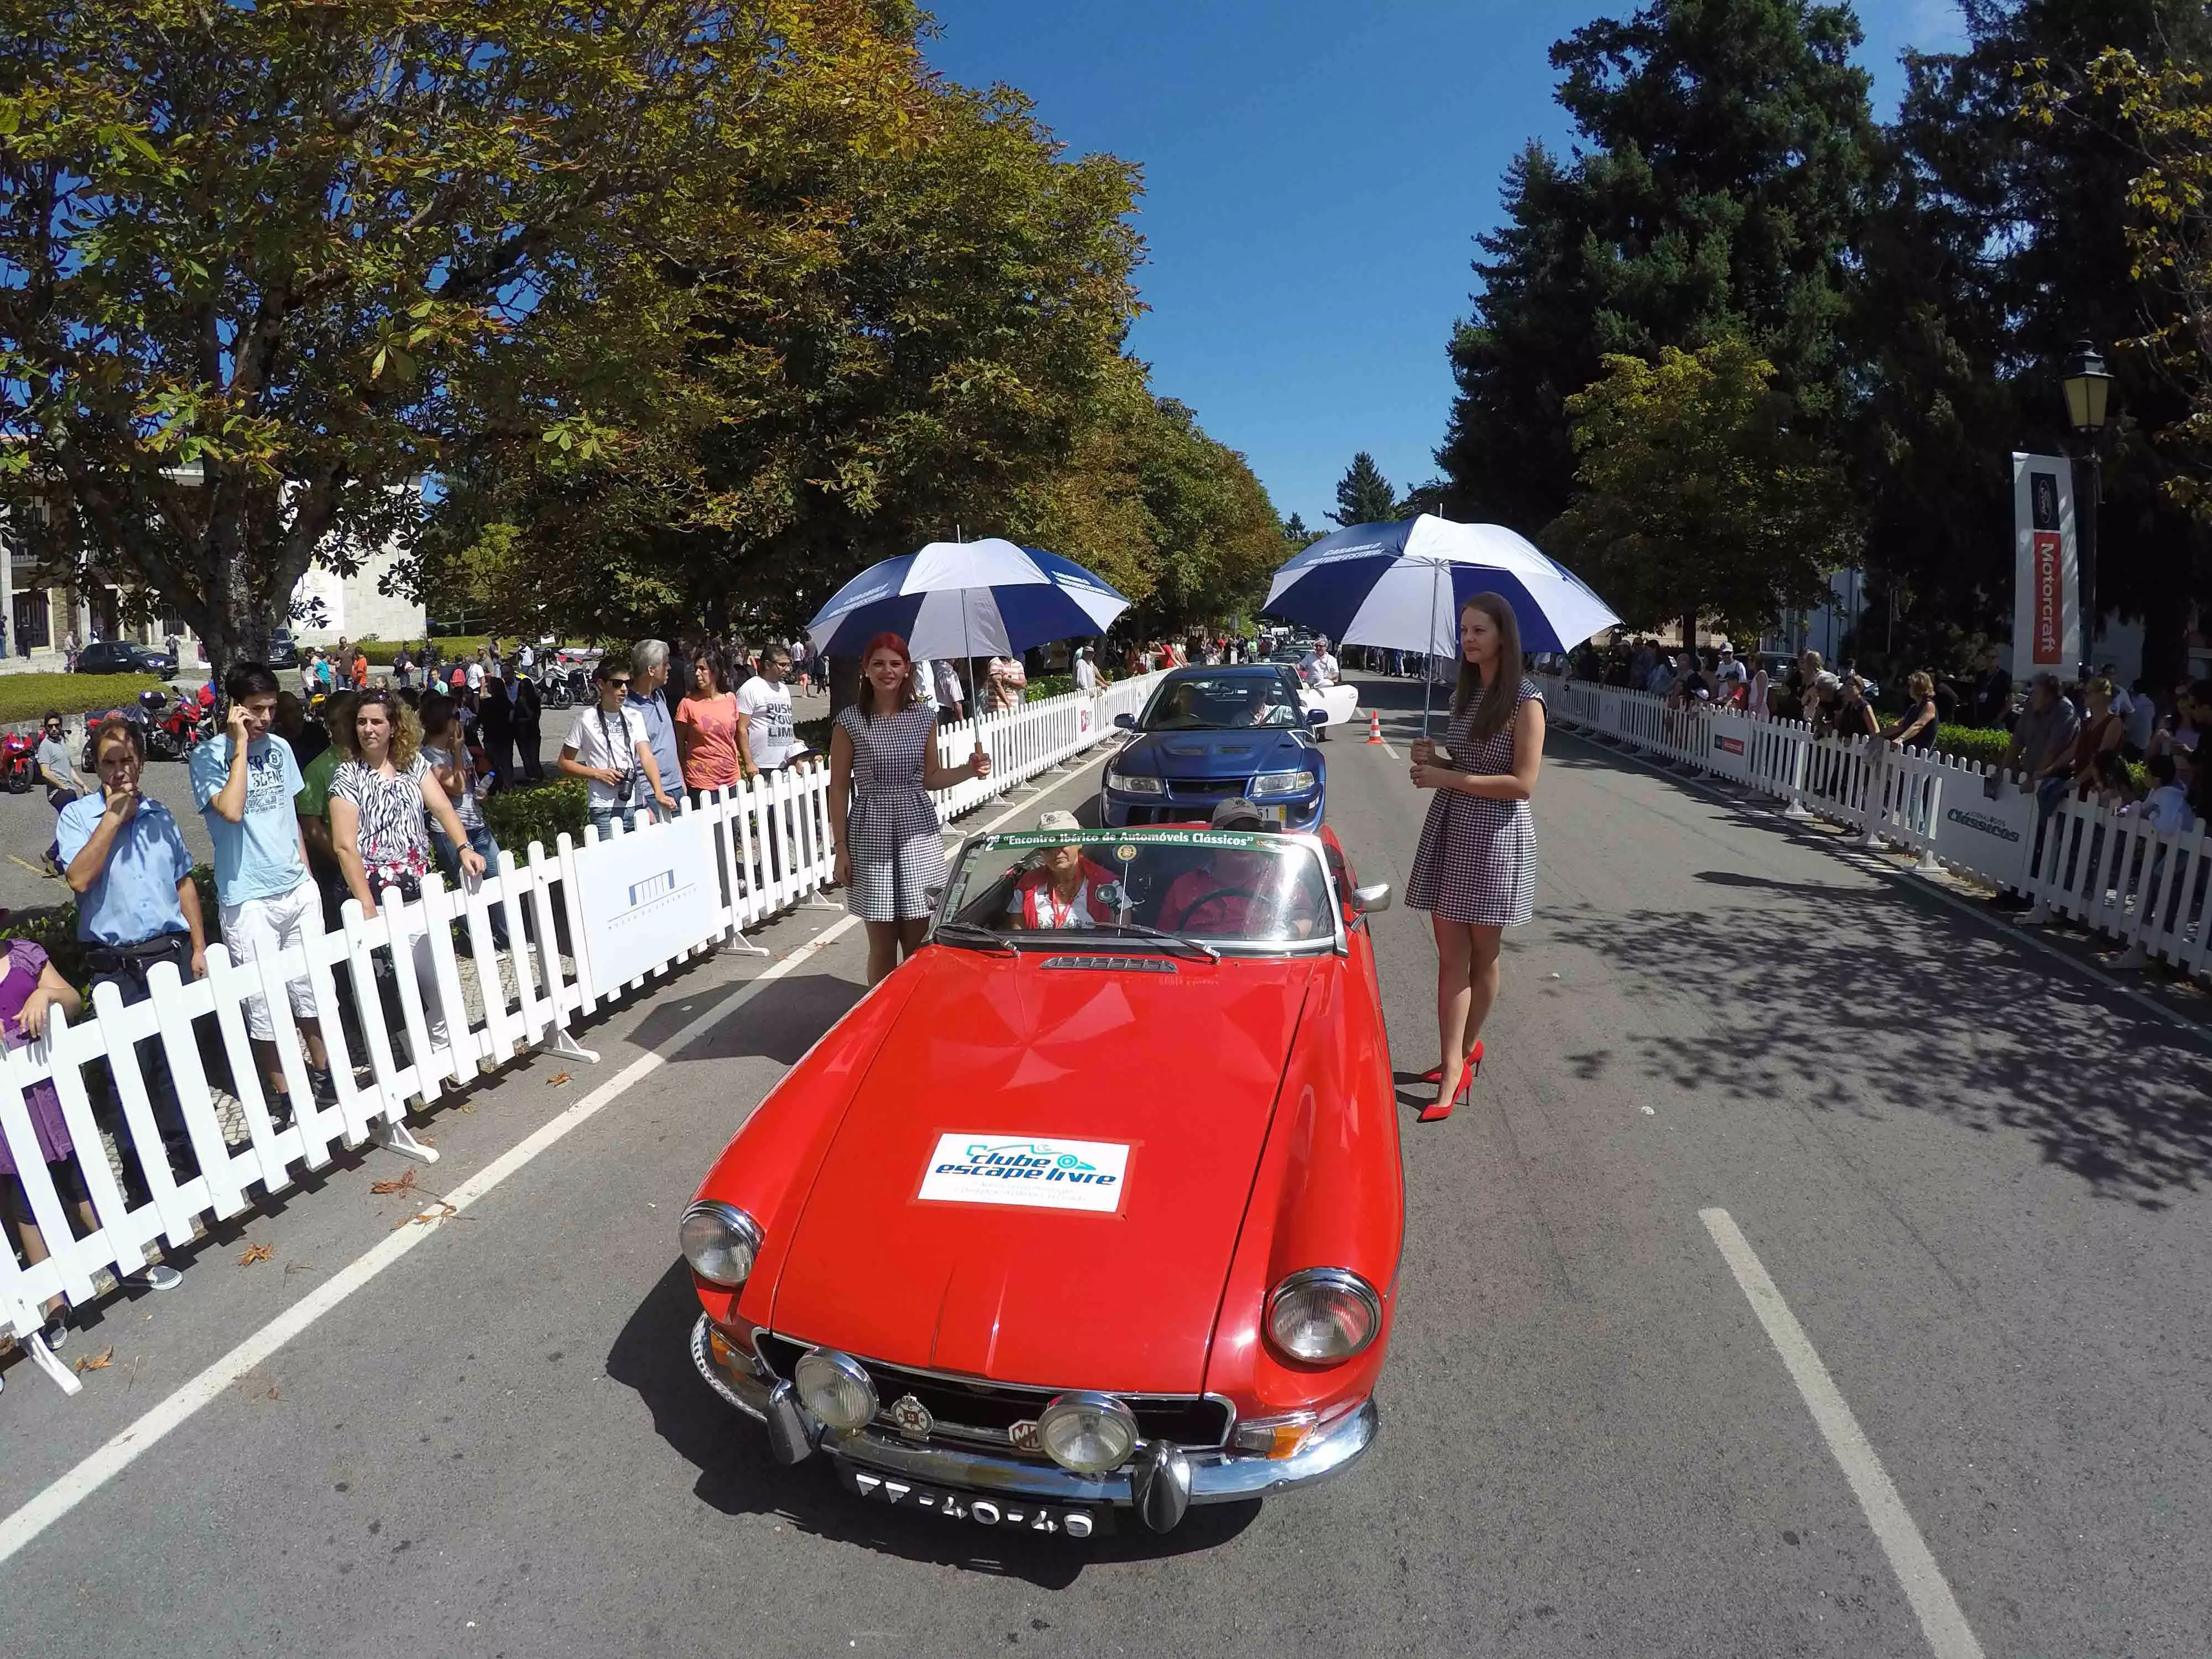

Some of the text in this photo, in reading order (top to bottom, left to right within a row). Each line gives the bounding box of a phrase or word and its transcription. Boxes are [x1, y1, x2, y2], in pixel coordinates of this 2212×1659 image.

[2041, 542, 2054, 652] Motorcraft
[1103, 832, 1116, 841] de
[1120, 832, 1189, 842] Automóveis
[971, 1153, 1051, 1167] clube
[935, 1164, 1117, 1185] escape livre
